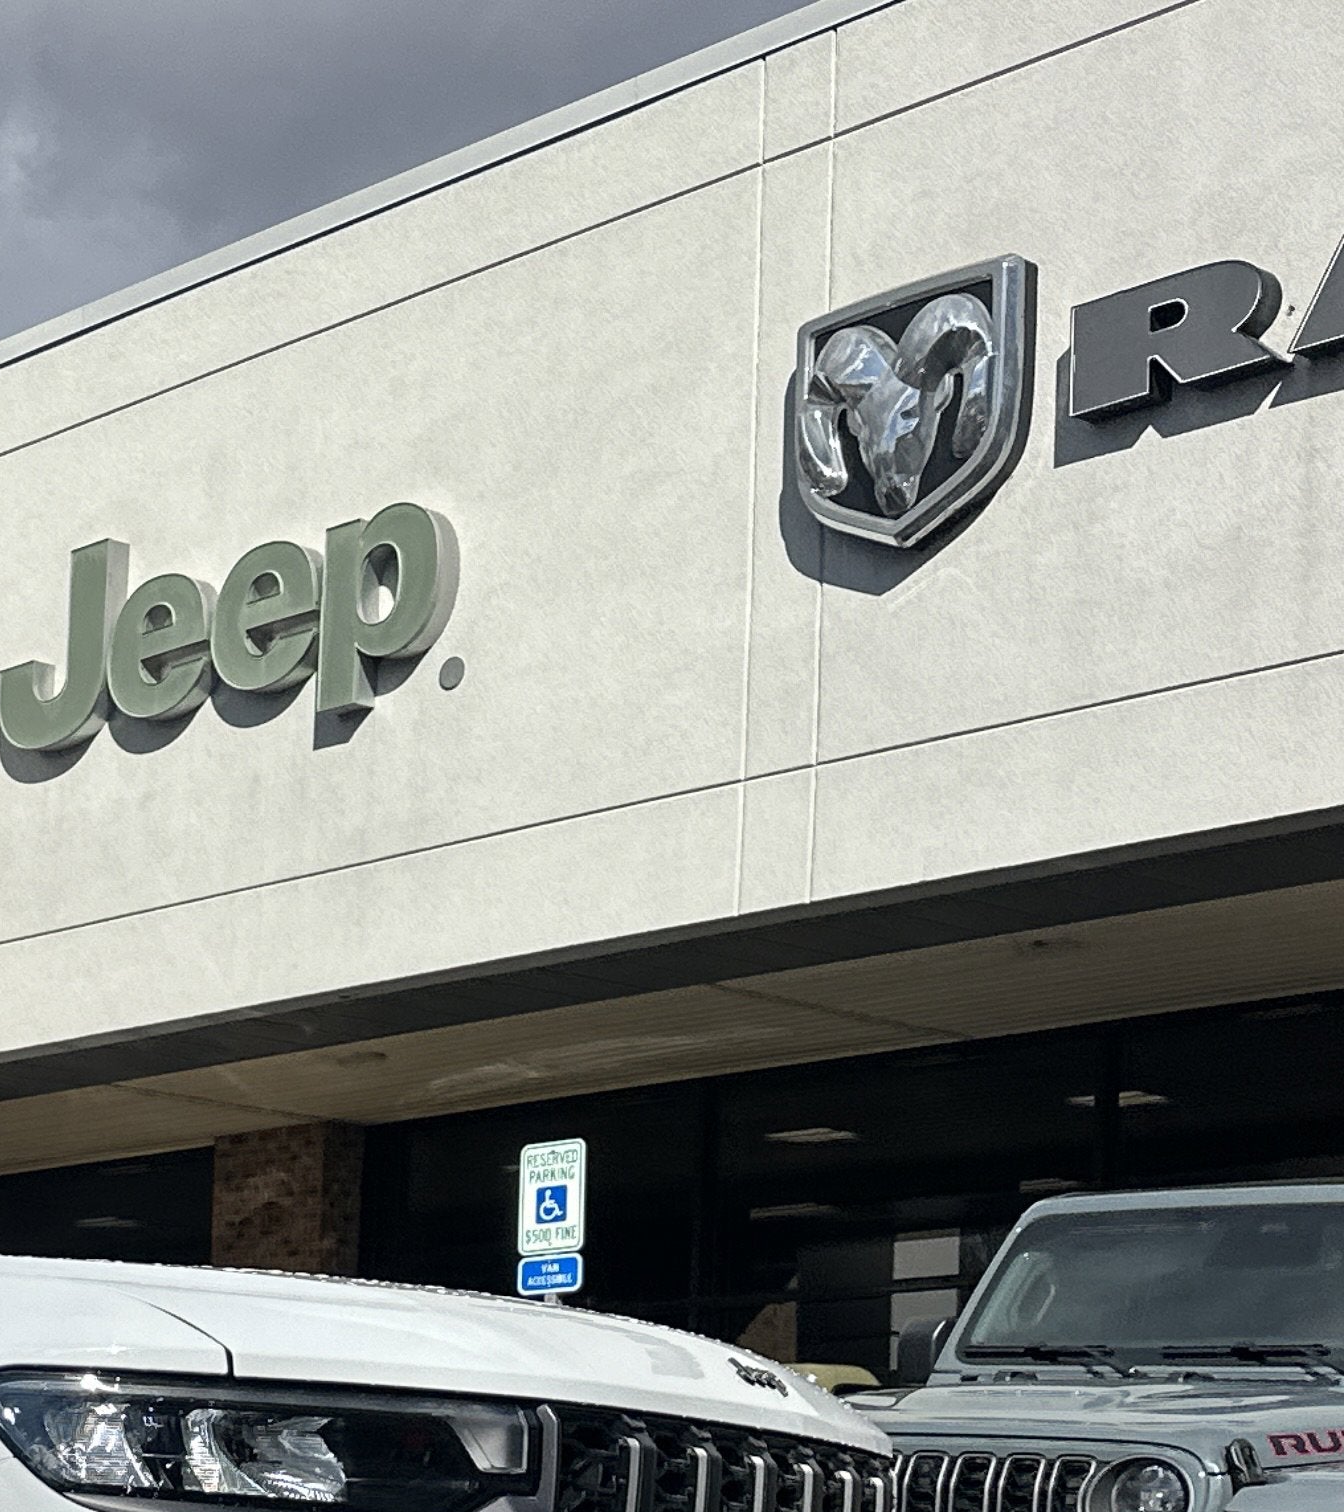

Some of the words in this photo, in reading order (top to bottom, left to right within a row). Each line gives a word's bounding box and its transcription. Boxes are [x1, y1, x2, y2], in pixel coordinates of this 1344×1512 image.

[527, 1149, 577, 1168] RESERVED
[529, 1165, 575, 1183] PARKING
[525, 1228, 551, 1244] $500
[555, 1224, 577, 1240] FINE
[541, 1263, 559, 1273] VAN
[1267, 1429, 1344, 1456] RU
